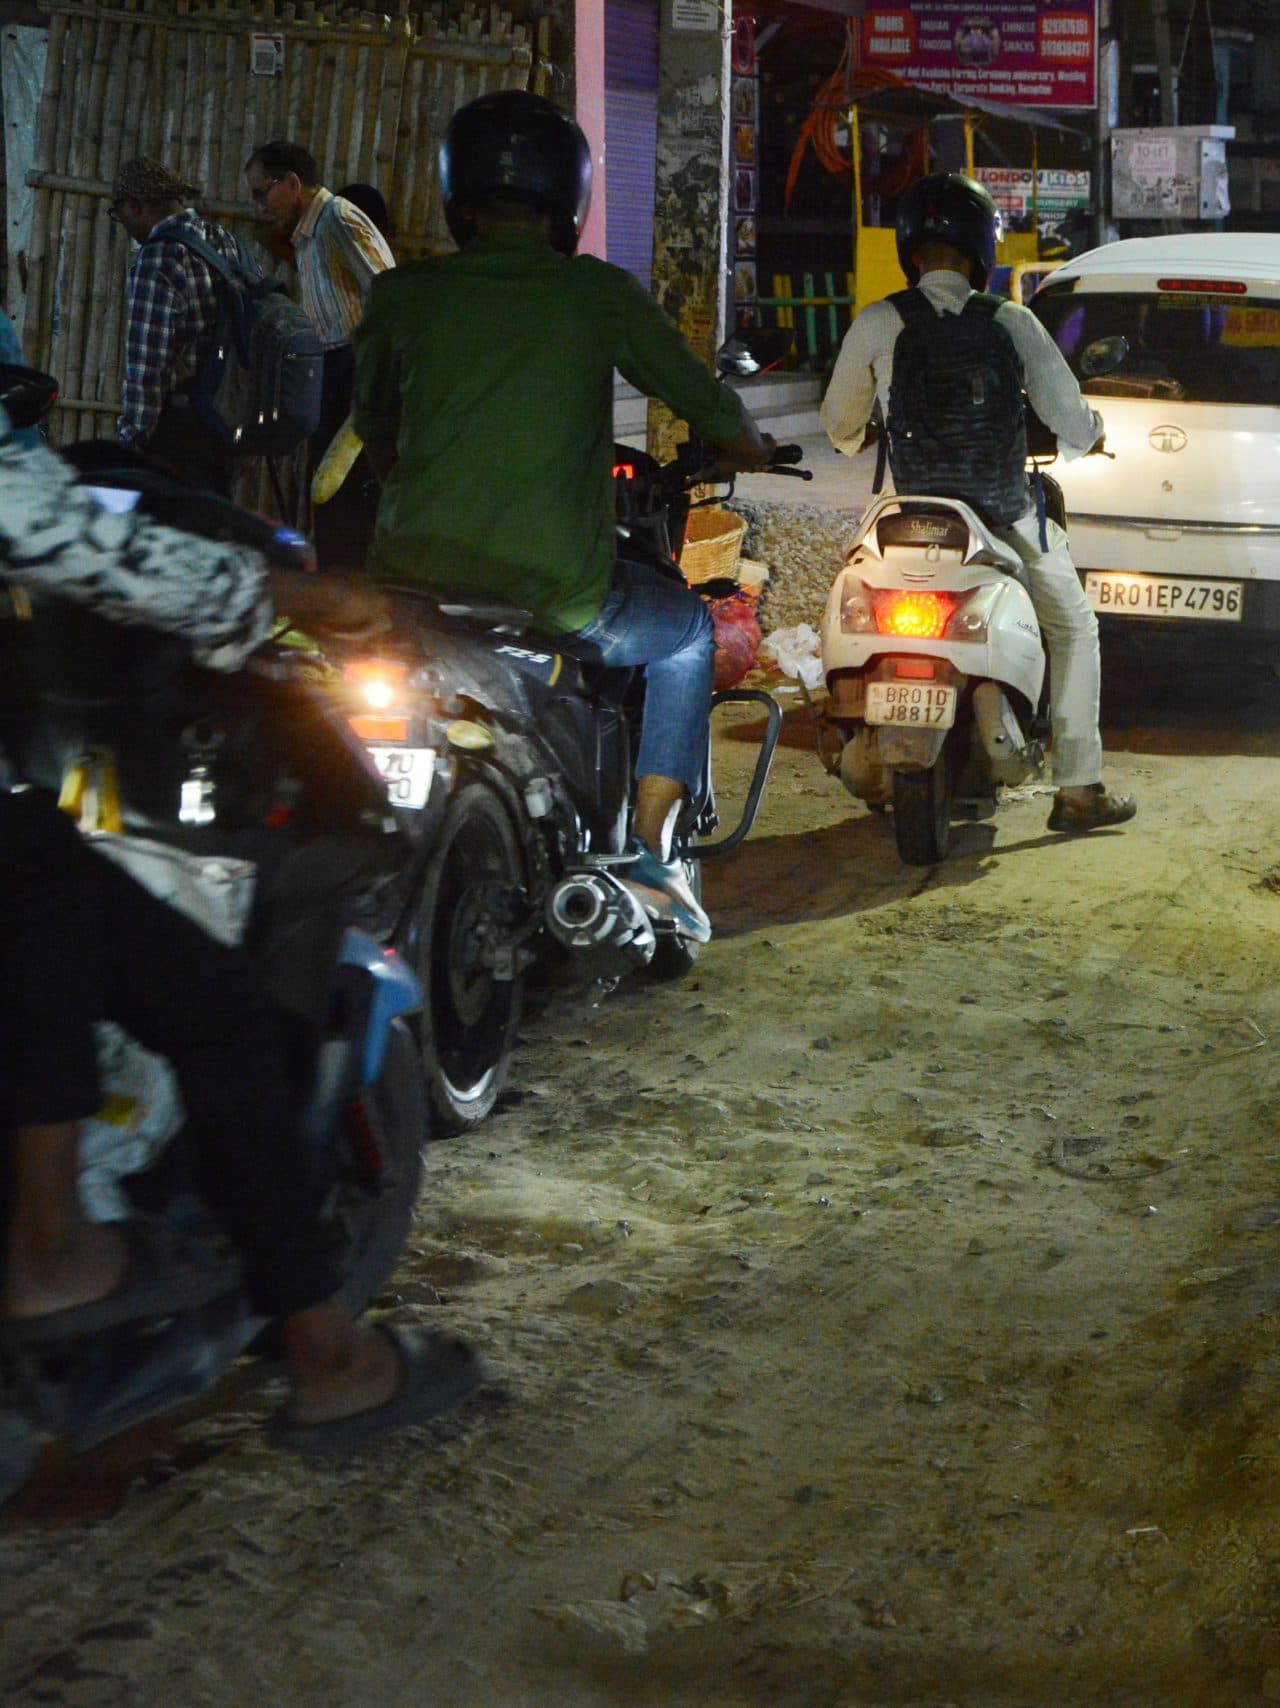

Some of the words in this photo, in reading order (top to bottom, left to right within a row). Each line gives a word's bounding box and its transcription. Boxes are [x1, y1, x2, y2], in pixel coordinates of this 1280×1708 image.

[1003, 41, 1035, 52] SNACKS
[911, 520, 949, 537] Shalimar
[1100, 581, 1239, 613] BR01EP4796
[887, 687, 947, 706] BR01D
[883, 704, 946, 724] J8817
